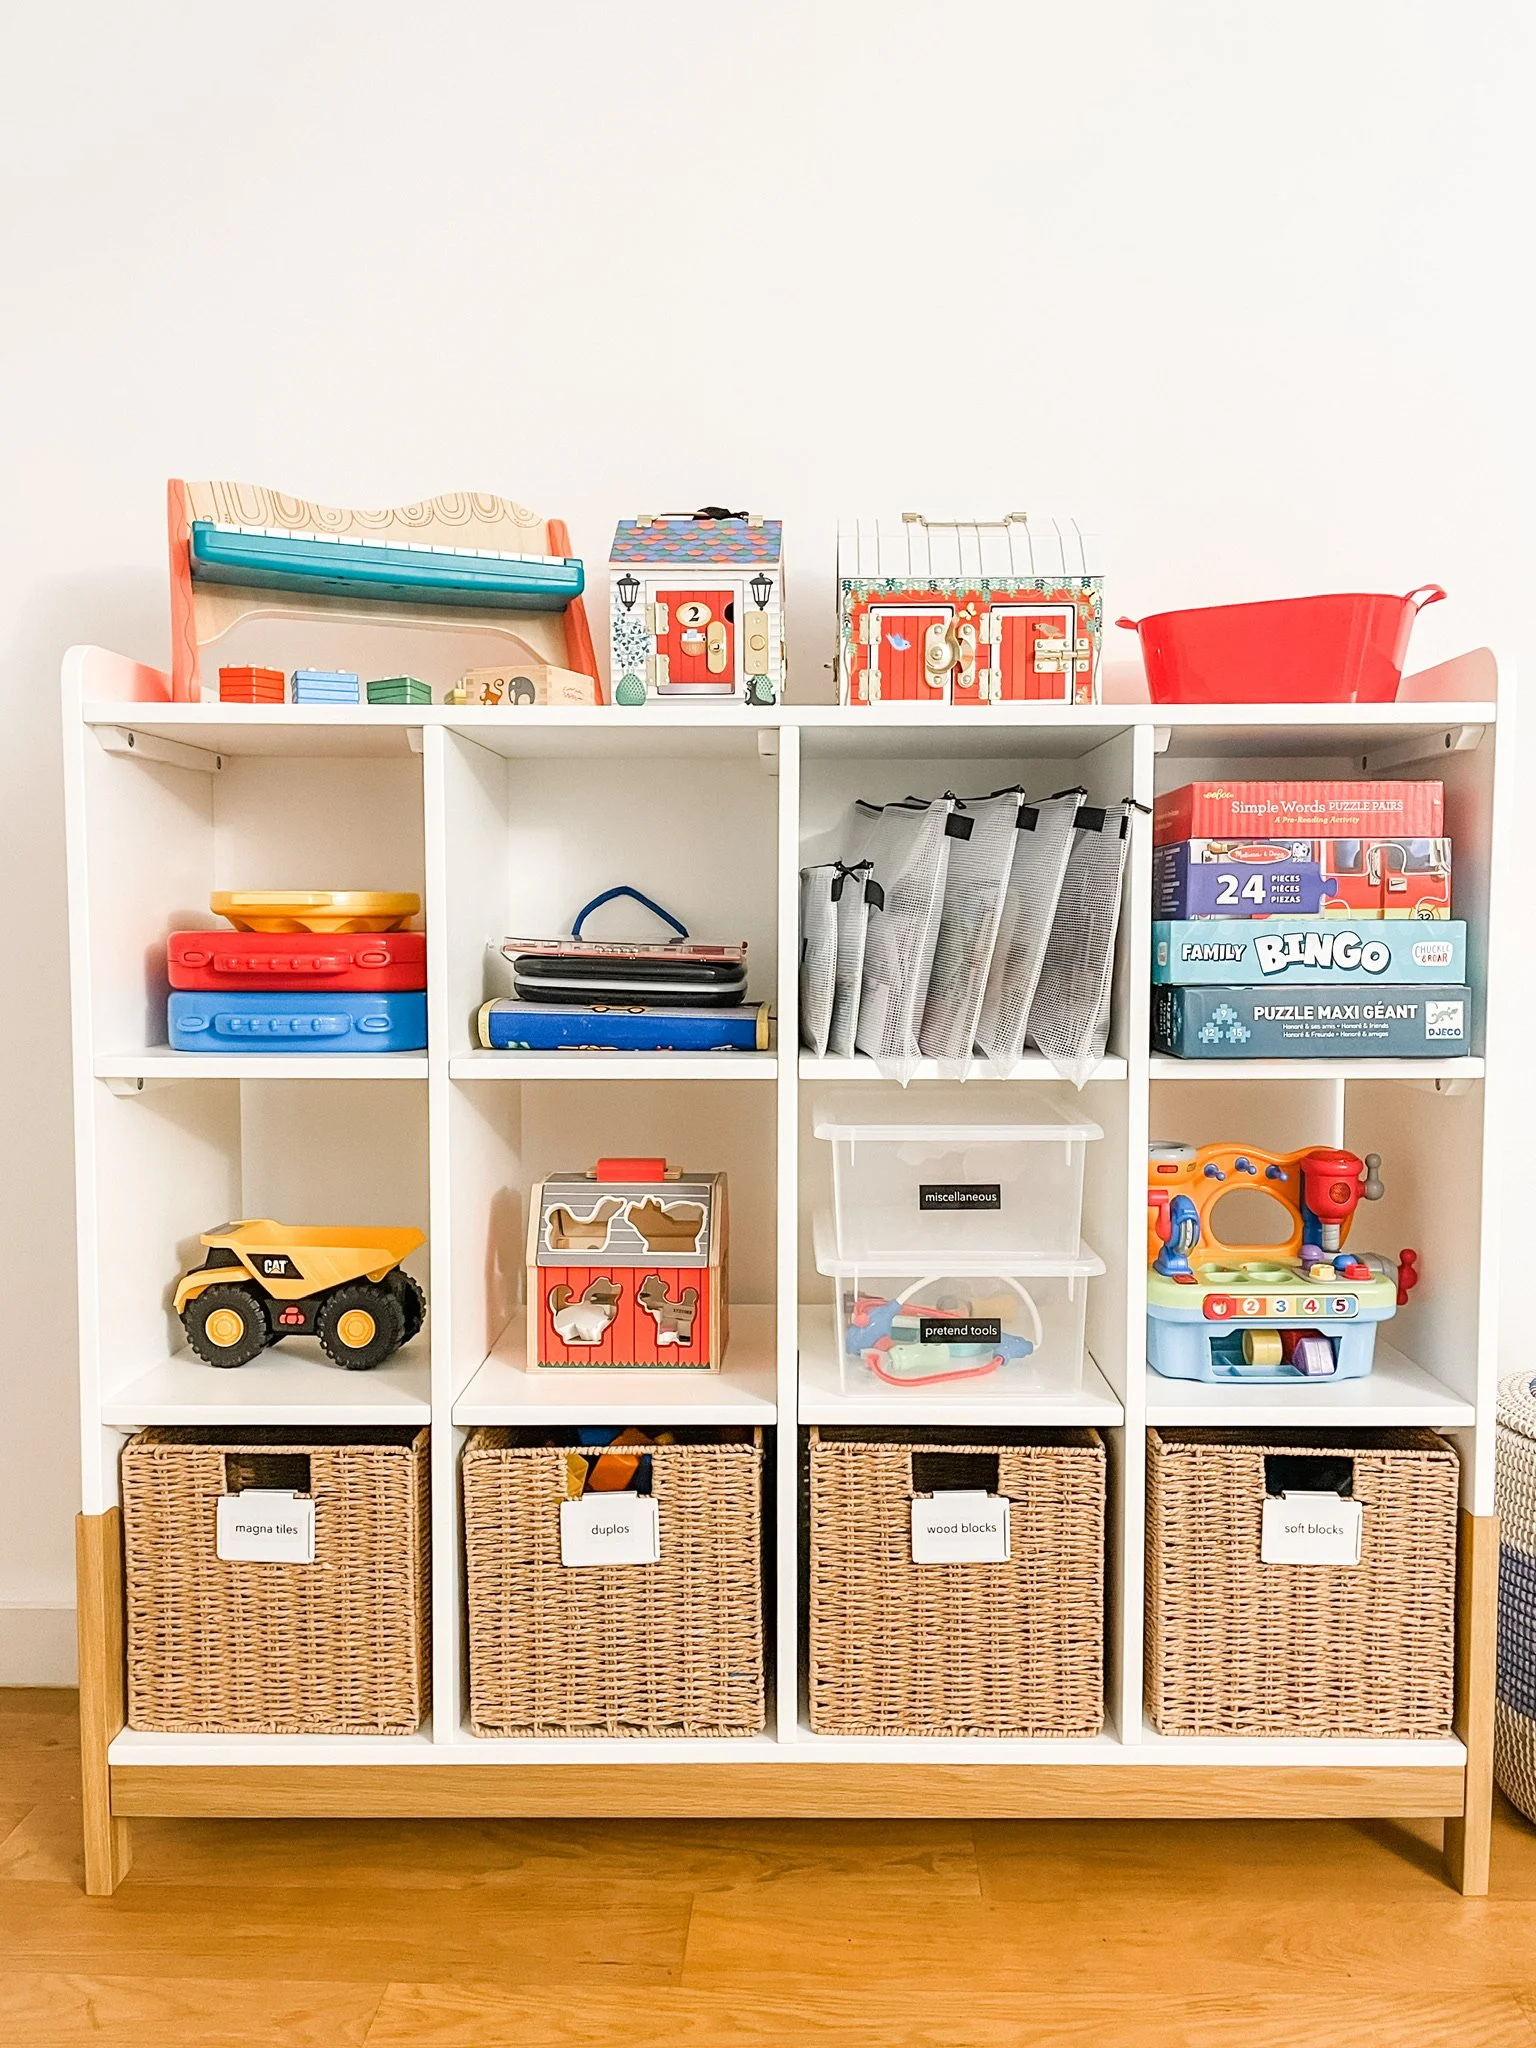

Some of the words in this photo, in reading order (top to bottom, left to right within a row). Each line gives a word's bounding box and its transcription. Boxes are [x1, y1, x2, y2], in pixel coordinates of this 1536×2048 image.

[688, 606, 700, 622] 2
[1231, 800, 1279, 816] Simple
[1280, 800, 1326, 813] Words
[1328, 801, 1369, 811] PUZZLE
[1372, 801, 1403, 811] PAIRS
[1281, 816, 1329, 825] Pre-Reading
[1329, 816, 1360, 825] Activity
[1216, 873, 1267, 905] 24
[1271, 884, 1301, 893] PIÈCES
[1181, 943, 1247, 962] FAMILY
[1254, 930, 1391, 976] BINGO
[1415, 945, 1451, 958] CHUCKLE
[1221, 1009, 1227, 1018] 9
[1254, 1005, 1314, 1020] PUZZLE
[1317, 1005, 1360, 1020] MAXI
[1362, 1001, 1418, 1020] GÉANT
[1204, 1028, 1215, 1036] 12
[1232, 1028, 1242, 1036] 15
[1428, 1028, 1461, 1036] DJECO
[925, 1191, 997, 1202] miscellaneous
[264, 1259, 287, 1274] CAT
[1247, 1300, 1255, 1311] 2
[1275, 1300, 1287, 1312] 3
[1304, 1299, 1317, 1312] 4
[1335, 1299, 1346, 1312] 5
[925, 1324, 968, 1338] pretend
[970, 1324, 998, 1335] tools
[235, 1524, 273, 1536] magna
[276, 1524, 298, 1535] tiles
[591, 1523, 630, 1536] duplos
[927, 1523, 958, 1534] wood
[961, 1522, 997, 1533] blocks
[1284, 1523, 1305, 1534] soft
[1308, 1523, 1344, 1535] blocks
